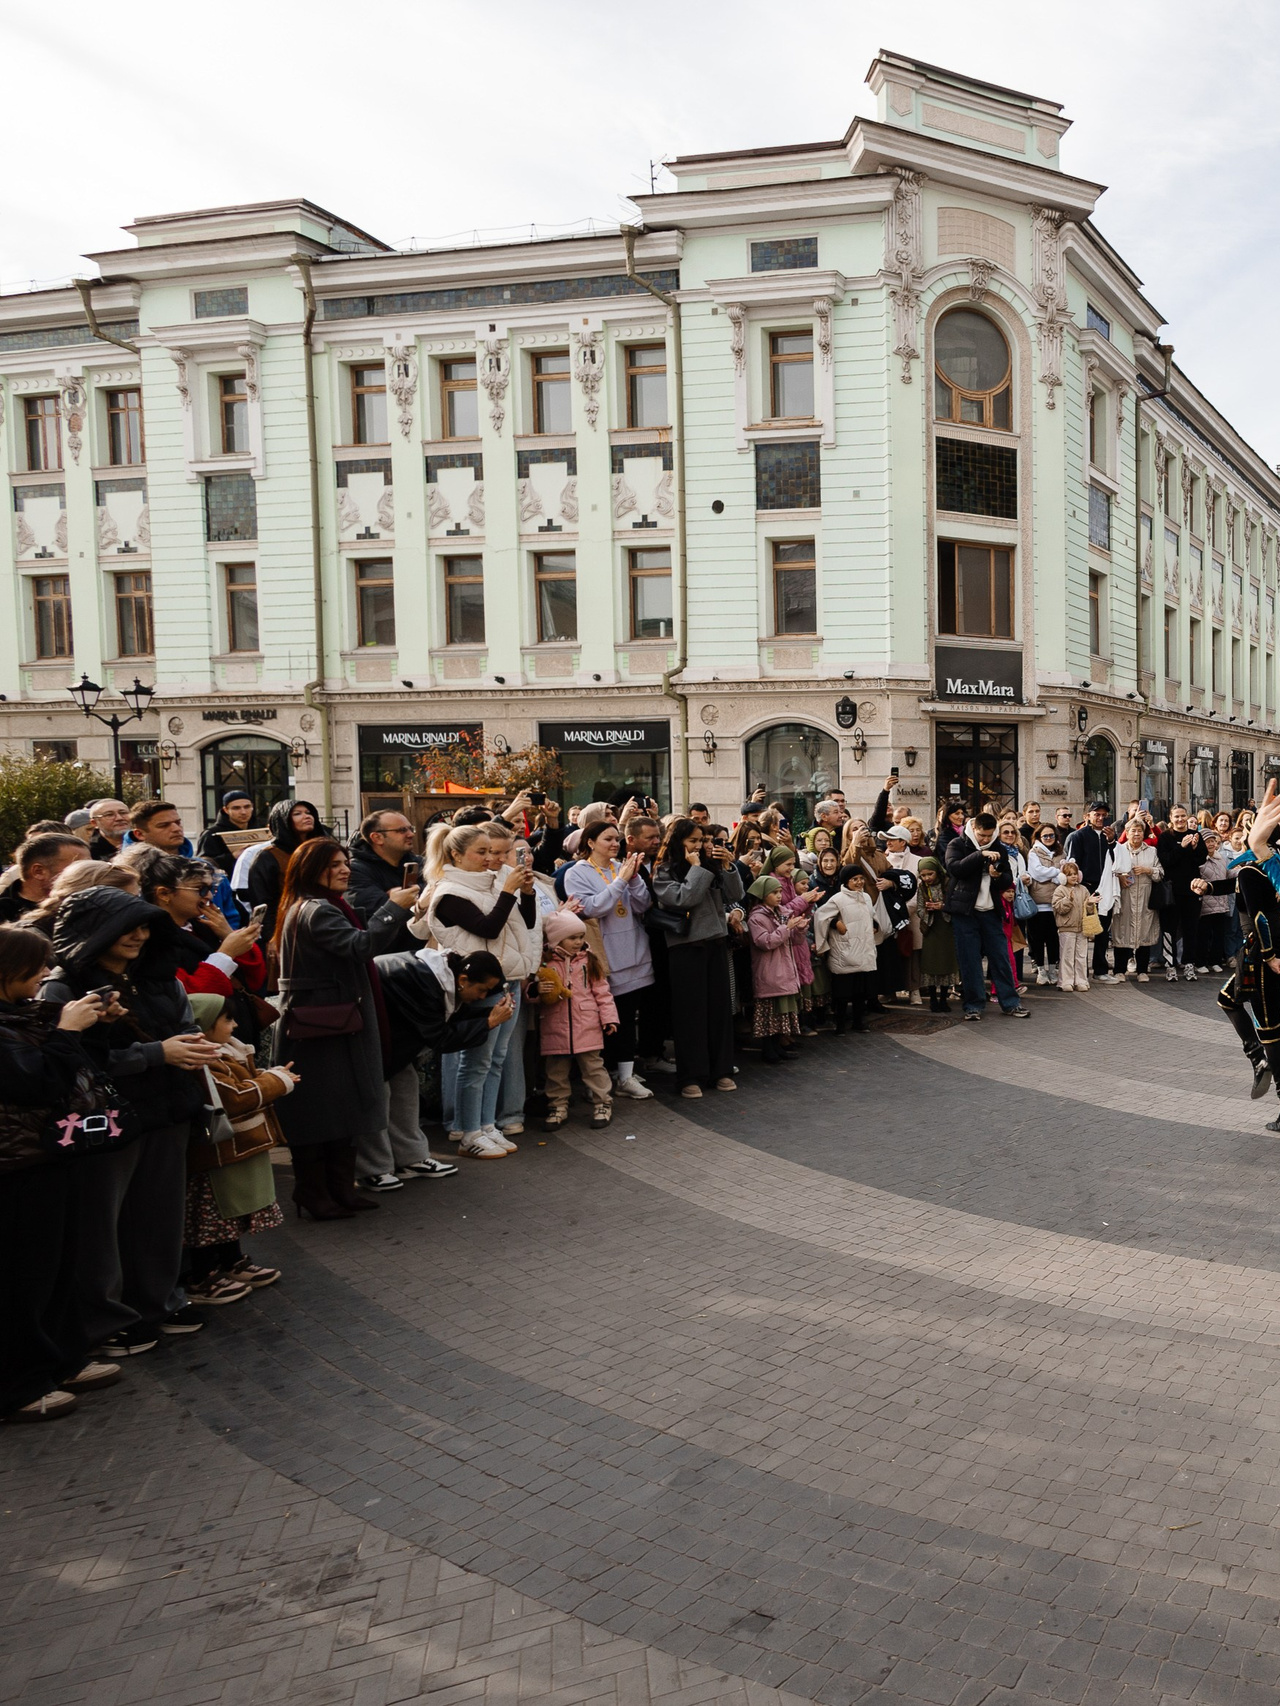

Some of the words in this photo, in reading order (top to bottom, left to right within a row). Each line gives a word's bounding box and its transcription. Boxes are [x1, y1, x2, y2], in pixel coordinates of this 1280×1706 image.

[946, 678, 1015, 697] MaxMara
[383, 733, 420, 744] MARINA
[422, 732, 459, 744] RINALDI
[564, 730, 604, 743] MARINA
[606, 730, 644, 743] RINALDI
[897, 788, 928, 796] MaxMara
